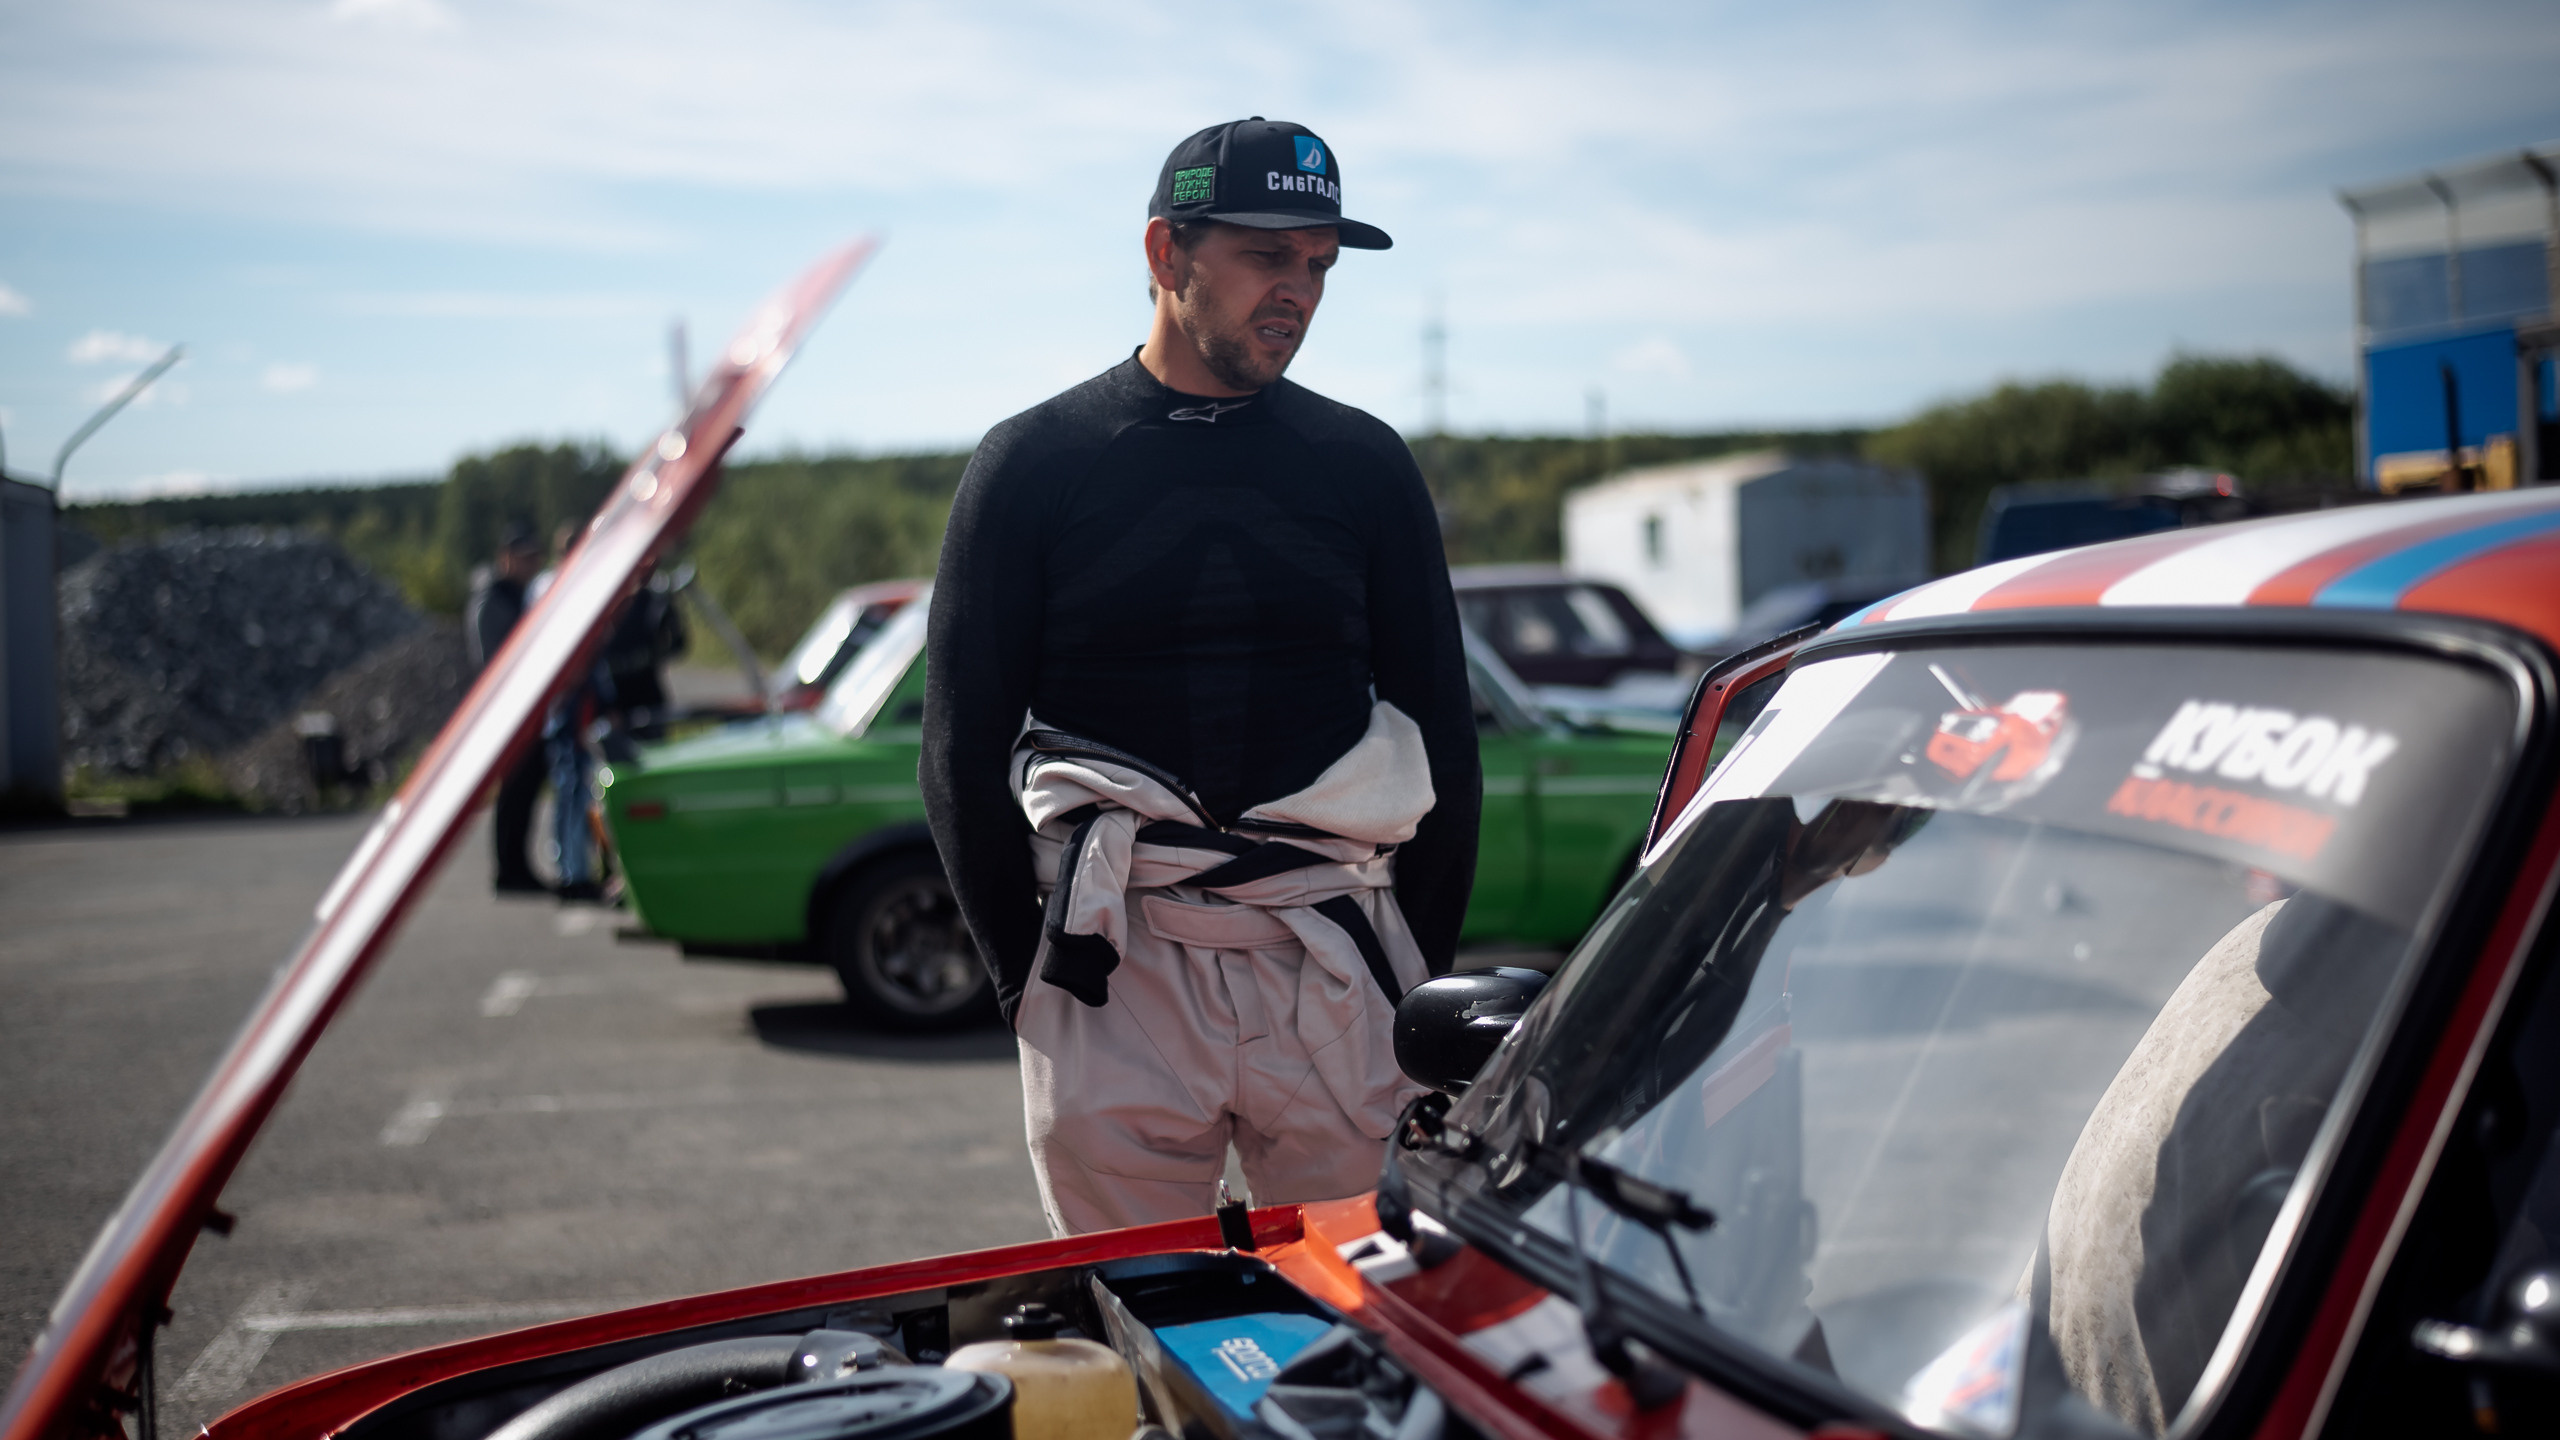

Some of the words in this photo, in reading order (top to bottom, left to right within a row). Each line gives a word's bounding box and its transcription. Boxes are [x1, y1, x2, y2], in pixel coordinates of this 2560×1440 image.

[1175, 167, 1213, 181] ПРИРОДЕ
[1175, 178, 1210, 191] НУЖНЫ
[1173, 188, 1210, 202] ГЕРОИ!
[2144, 699, 2398, 806] КУБОК
